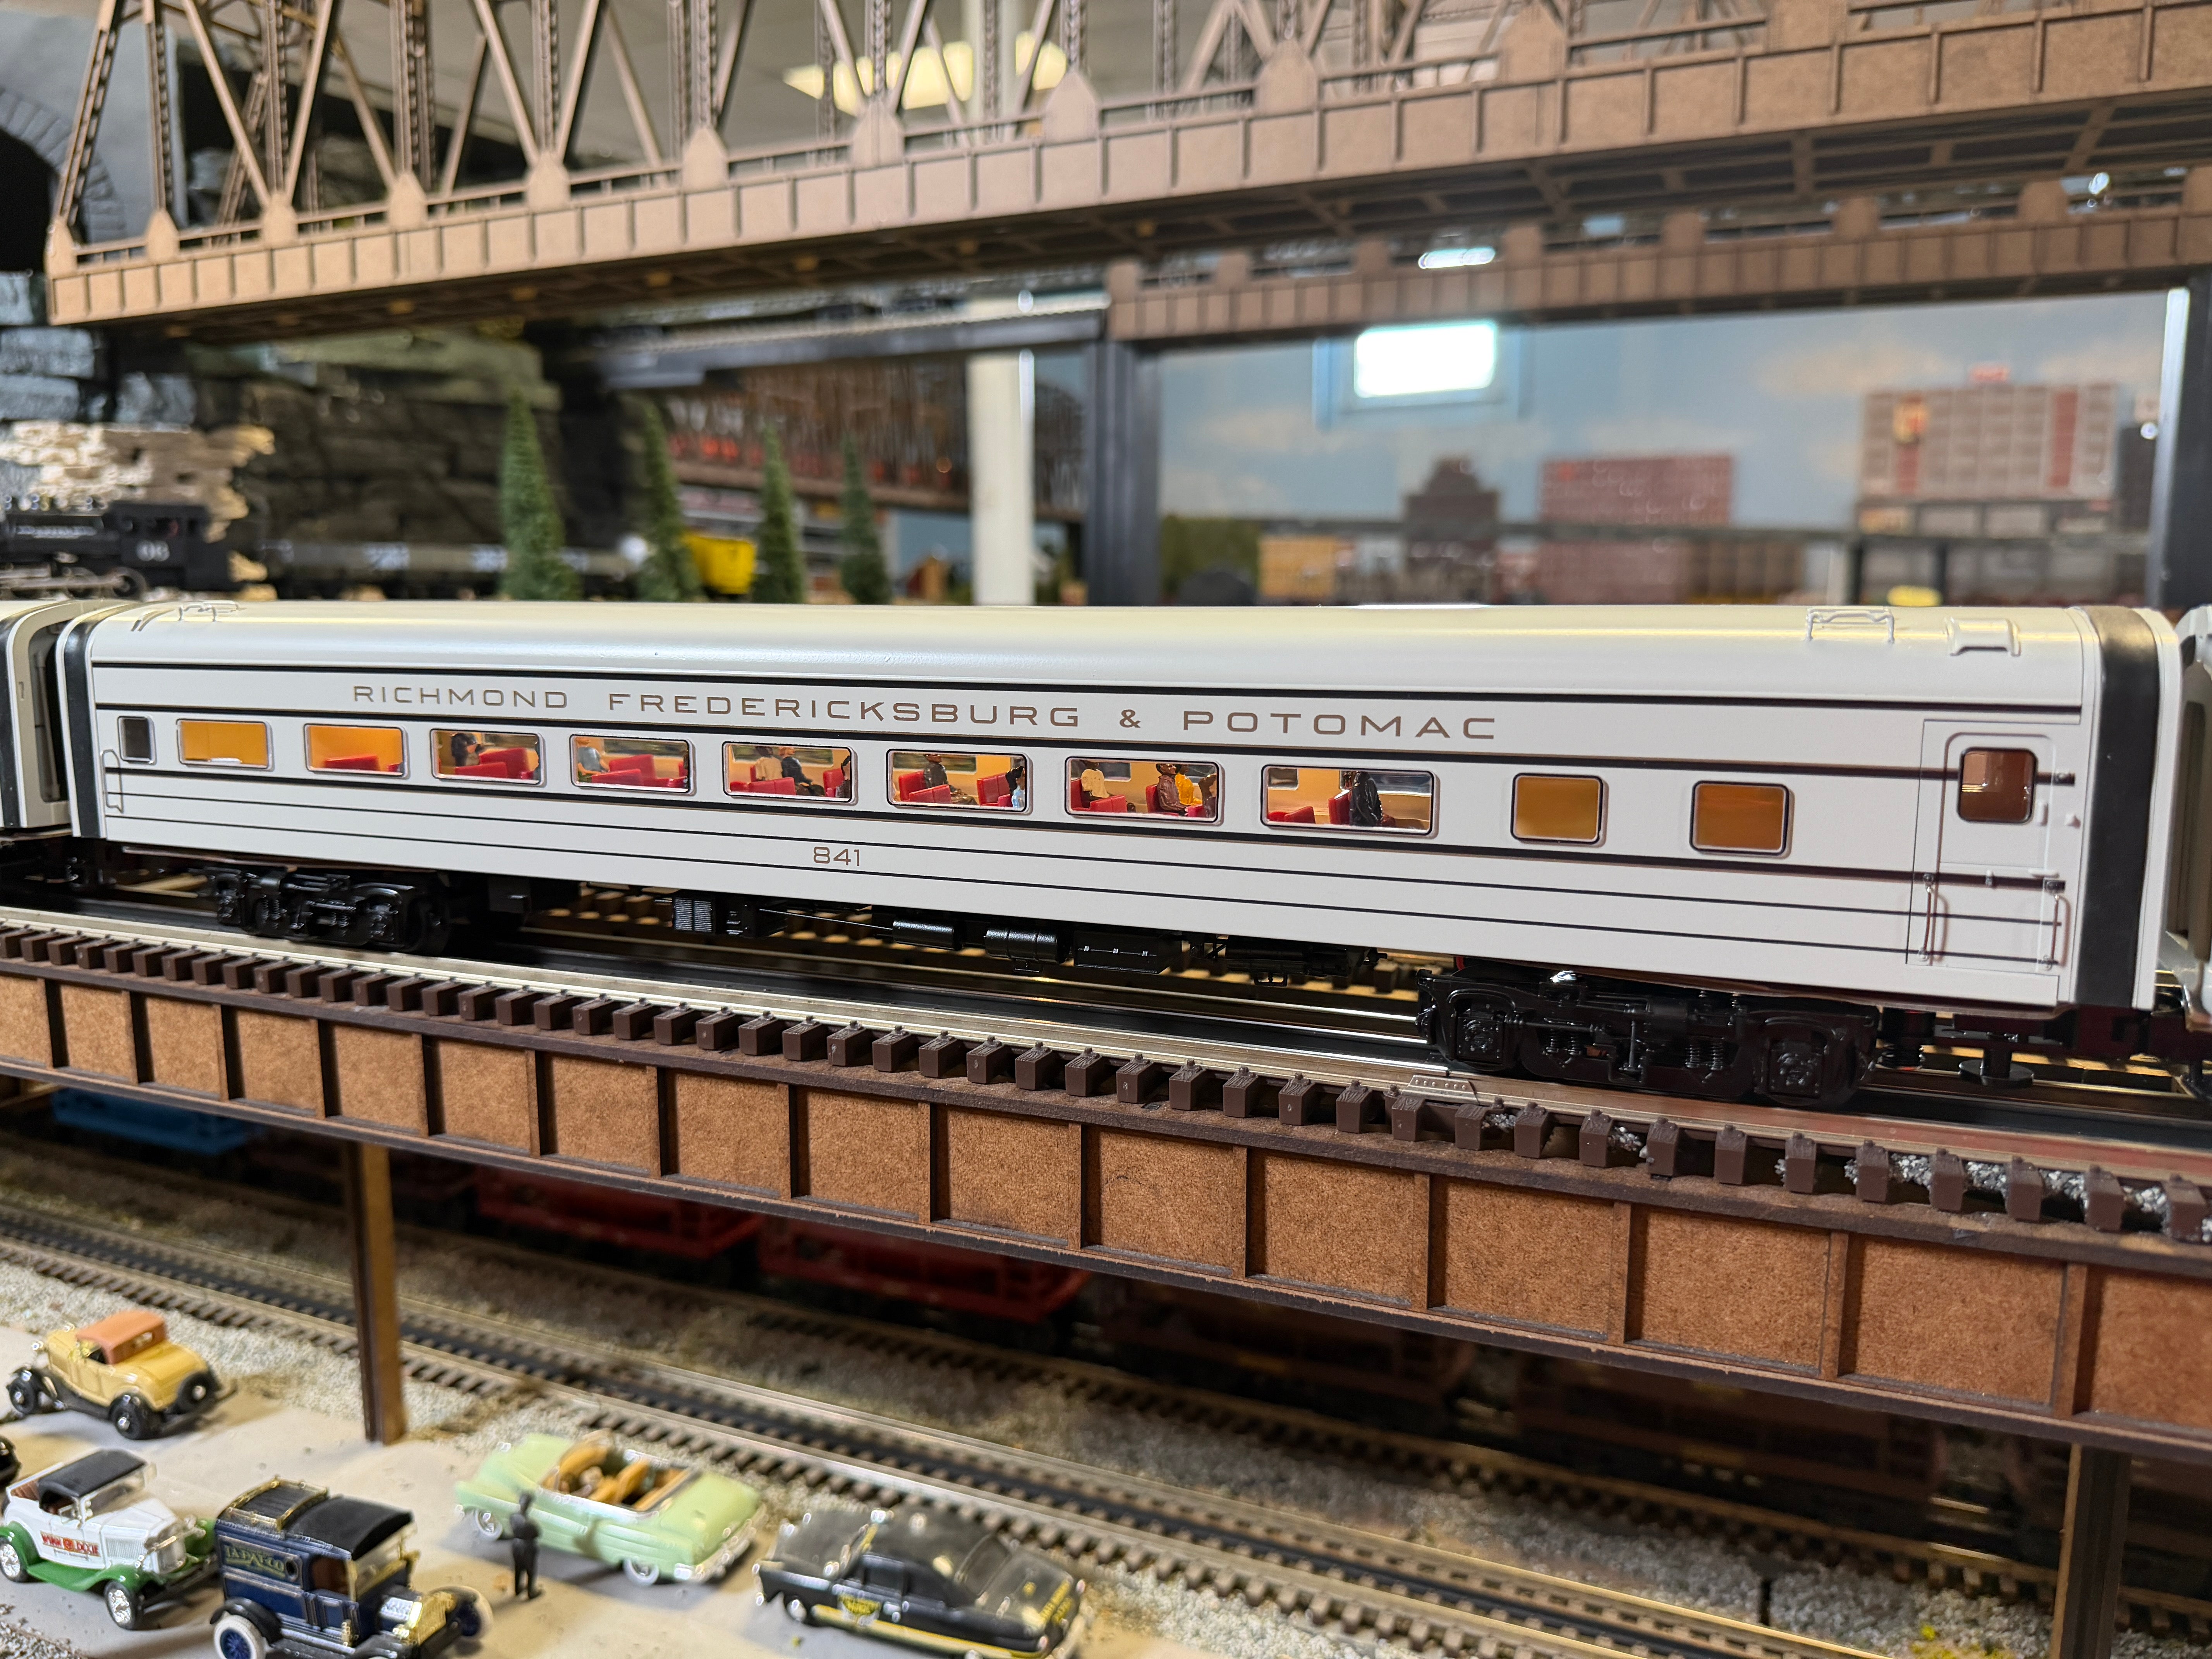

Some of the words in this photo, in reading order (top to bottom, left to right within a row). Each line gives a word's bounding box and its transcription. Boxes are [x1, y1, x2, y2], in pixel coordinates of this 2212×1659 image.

[353, 685, 567, 709] RICHMOND
[609, 693, 1079, 727] FREDERICKSBURG
[1119, 709, 1141, 729] &
[1183, 710, 1495, 740] POTOMAC
[813, 846, 860, 867] 841
